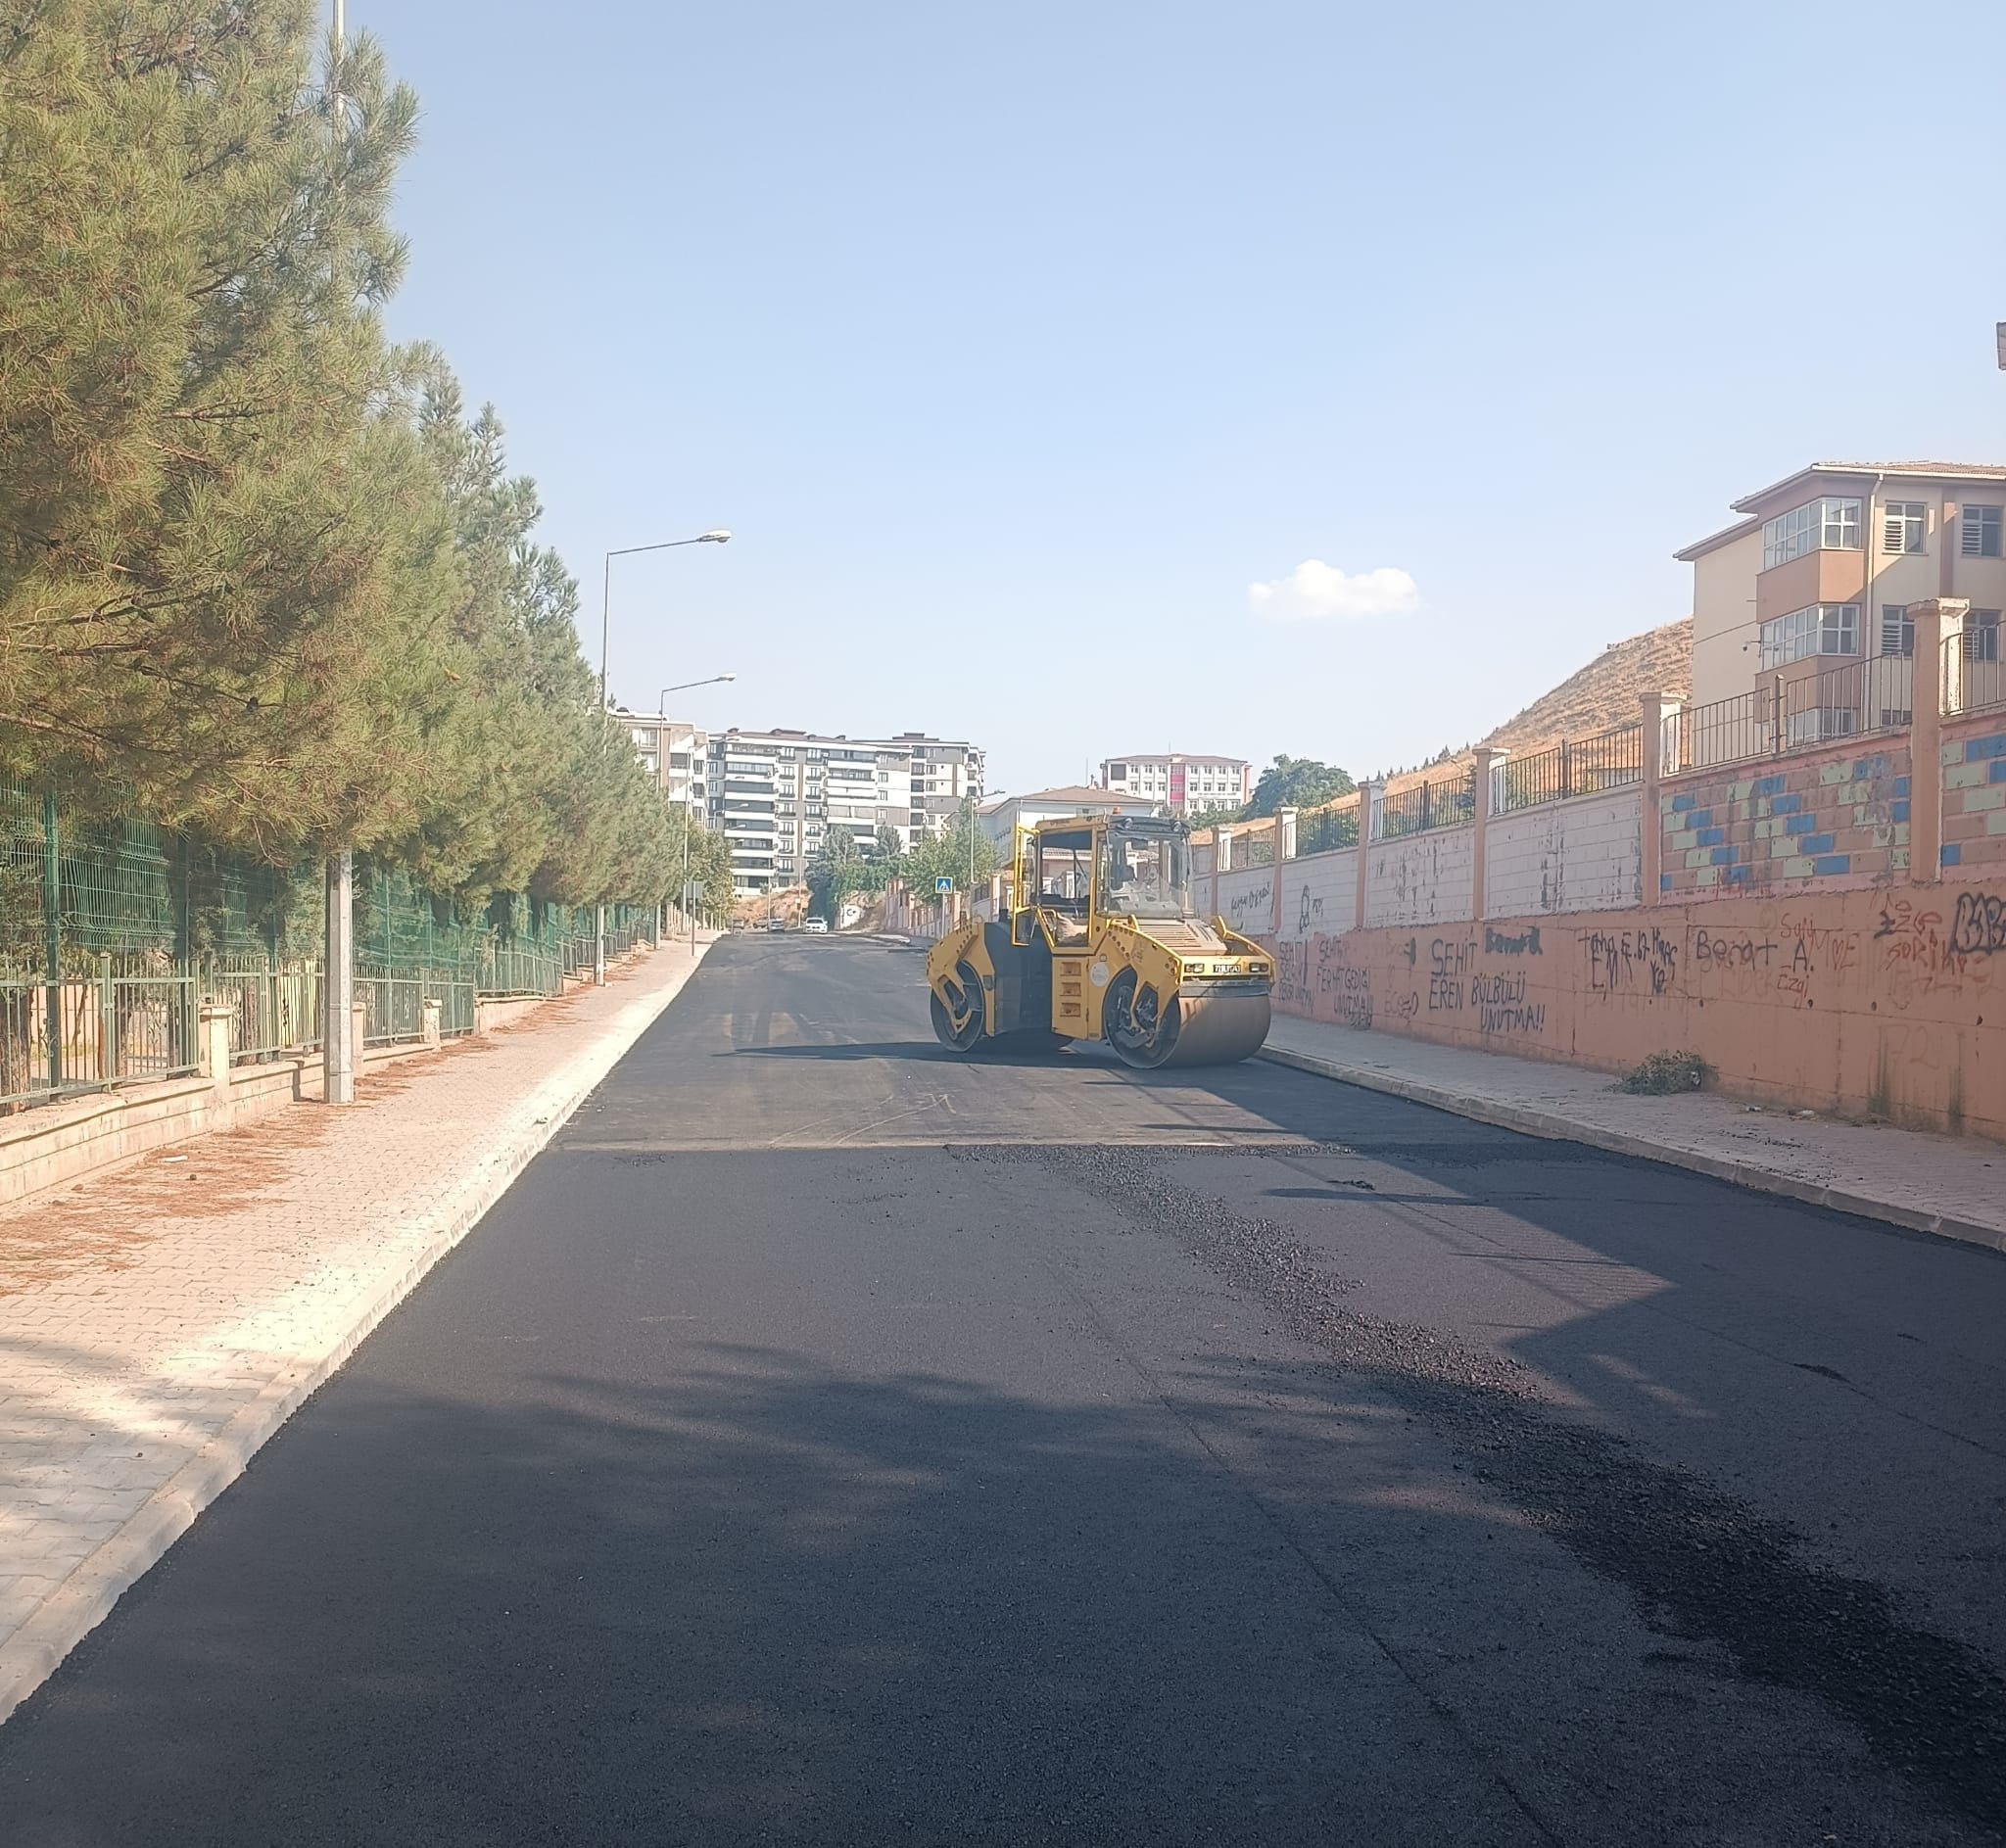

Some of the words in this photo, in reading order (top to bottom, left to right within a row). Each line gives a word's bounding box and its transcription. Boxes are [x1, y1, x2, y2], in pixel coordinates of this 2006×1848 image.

[1429, 978, 1464, 1011] EREN
[1471, 971, 1526, 1006] BÜLBÜLÜ
[1481, 1002, 1546, 1034] UNUTMA!!
